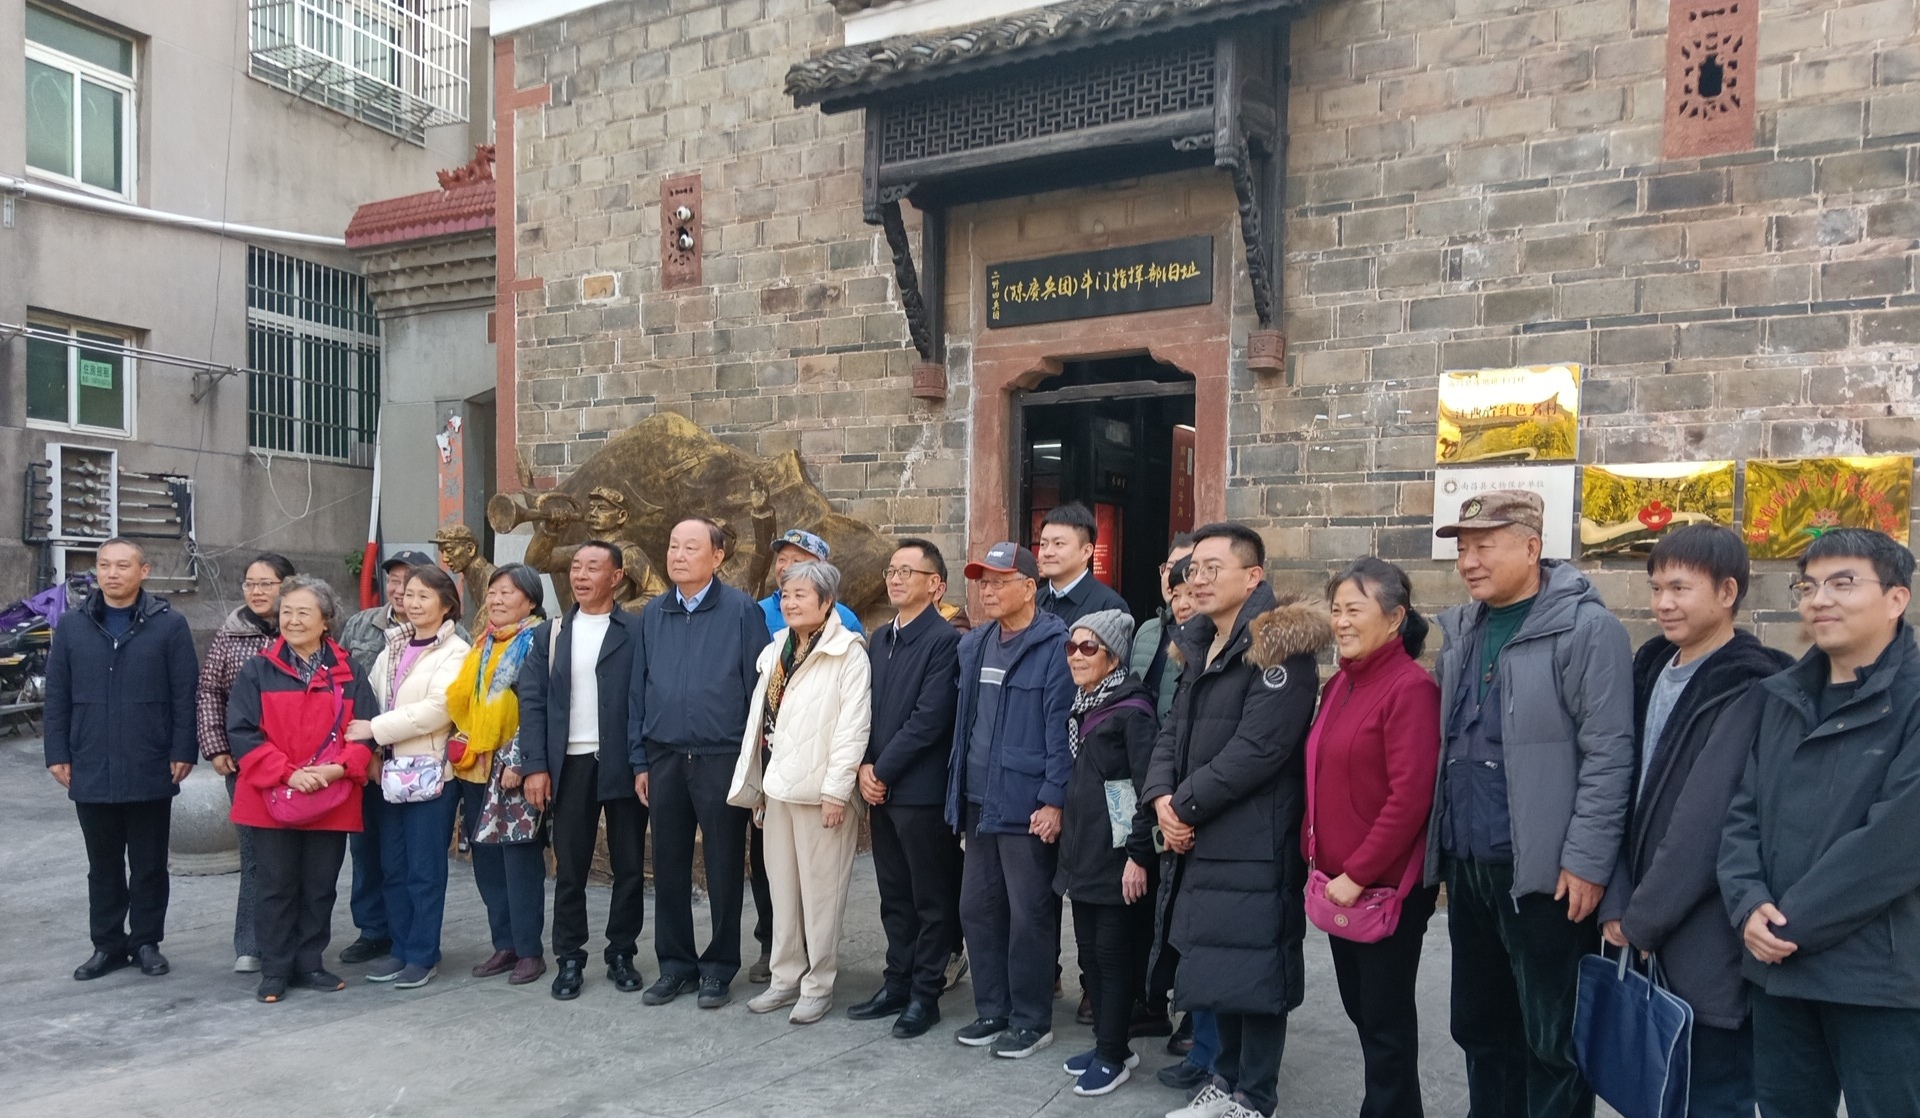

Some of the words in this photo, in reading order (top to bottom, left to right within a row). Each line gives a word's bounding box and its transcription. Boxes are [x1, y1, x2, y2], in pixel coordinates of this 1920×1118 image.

[1455, 400, 1557, 420] 江西省红色名村
[1461, 480, 1545, 491] 南昌县文物保护单位
